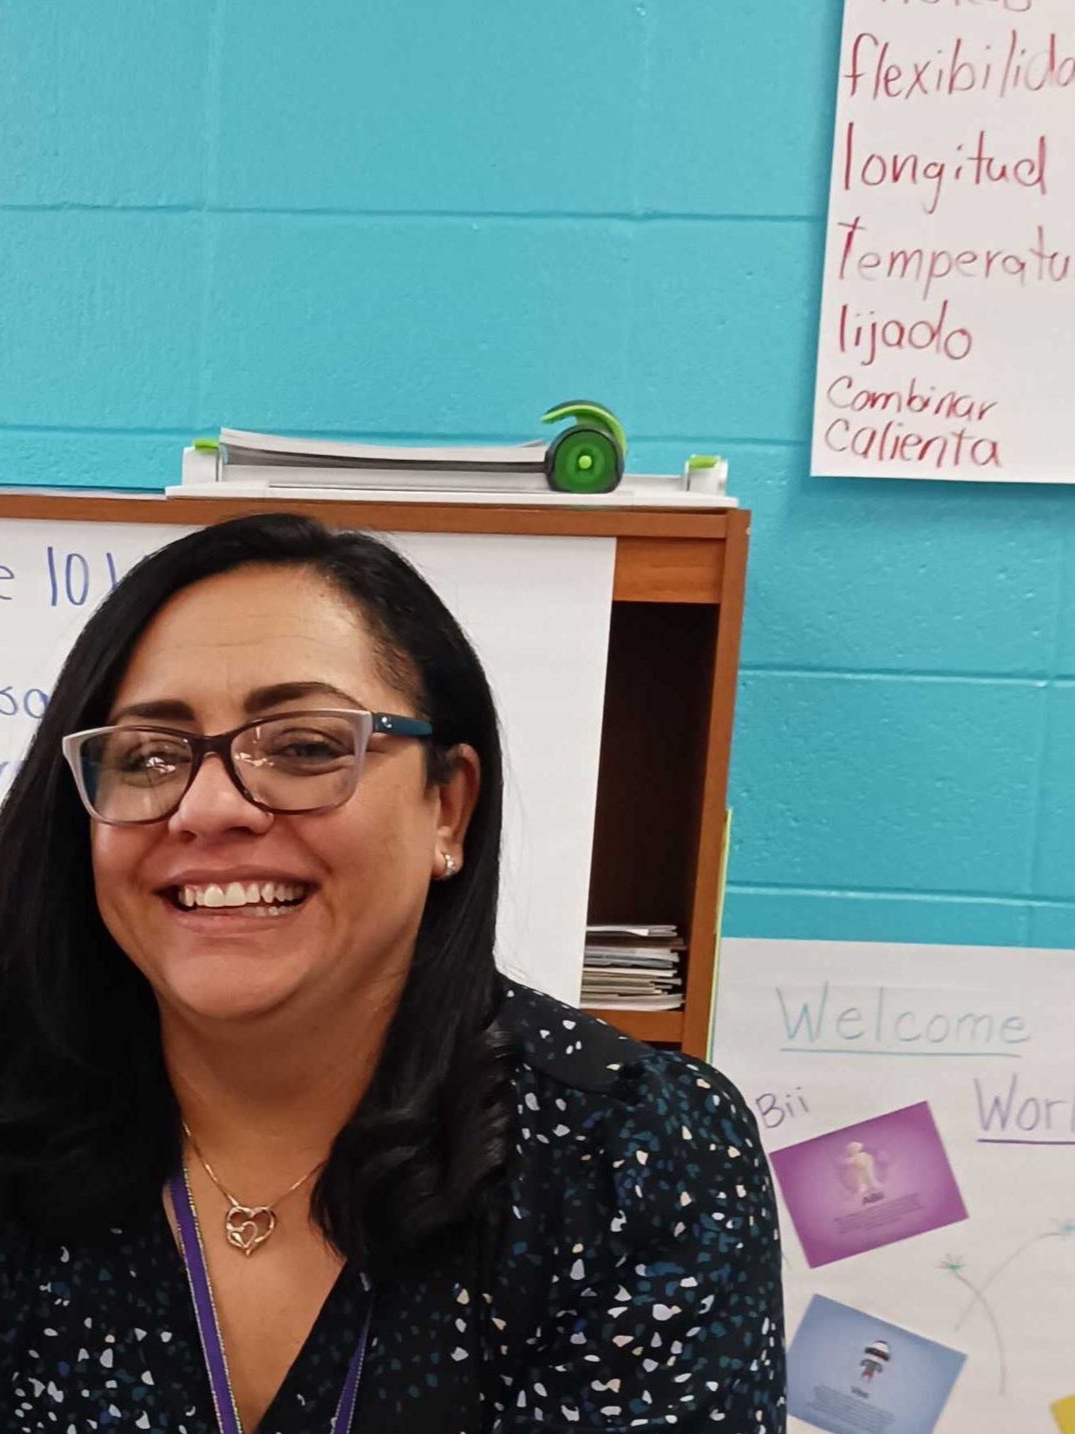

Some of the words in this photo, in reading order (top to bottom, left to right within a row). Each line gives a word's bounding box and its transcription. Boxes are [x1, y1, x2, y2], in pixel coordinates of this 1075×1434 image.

[843, 122, 1046, 214] longitud
[839, 299, 972, 366] lijado
[47, 546, 90, 606] 10
[776, 980, 1031, 1044] Welcome
